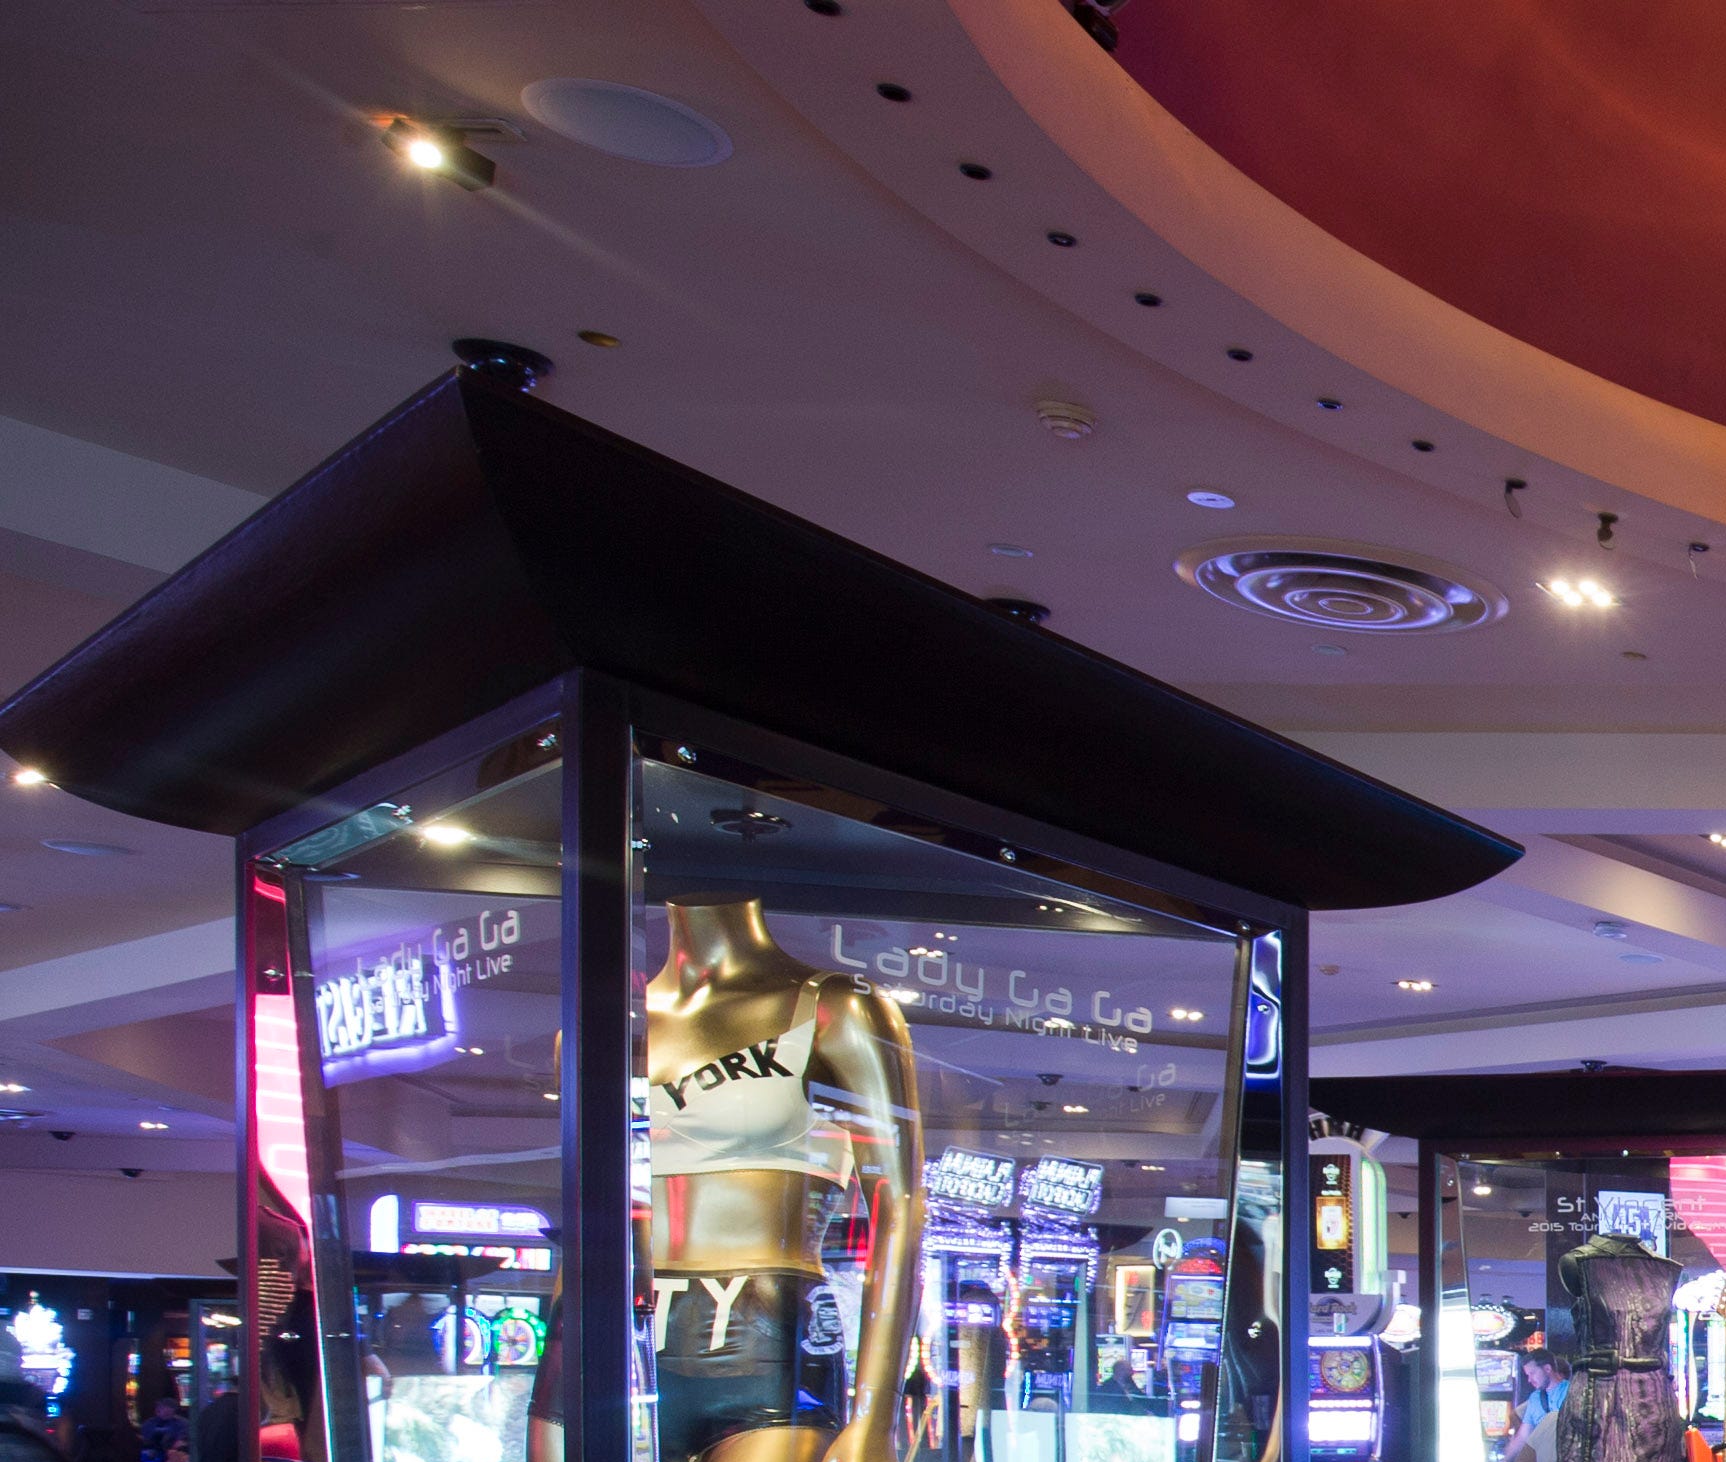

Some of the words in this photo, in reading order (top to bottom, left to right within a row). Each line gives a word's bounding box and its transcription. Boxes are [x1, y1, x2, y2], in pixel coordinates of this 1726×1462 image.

[433, 927, 469, 967] Ga
[479, 910, 521, 951] Ga
[476, 953, 513, 981] Live
[831, 924, 985, 1003] Lady
[1008, 970, 1073, 1016] Ga
[1093, 991, 1153, 1034] Ga
[1085, 1023, 1139, 1050] Live
[662, 1037, 794, 1112] YORK
[1556, 1195, 1587, 1213] St
[1528, 1222, 1565, 1232] 2015
[1568, 1222, 1601, 1232] Tour
[652, 1275, 749, 1352] TY
